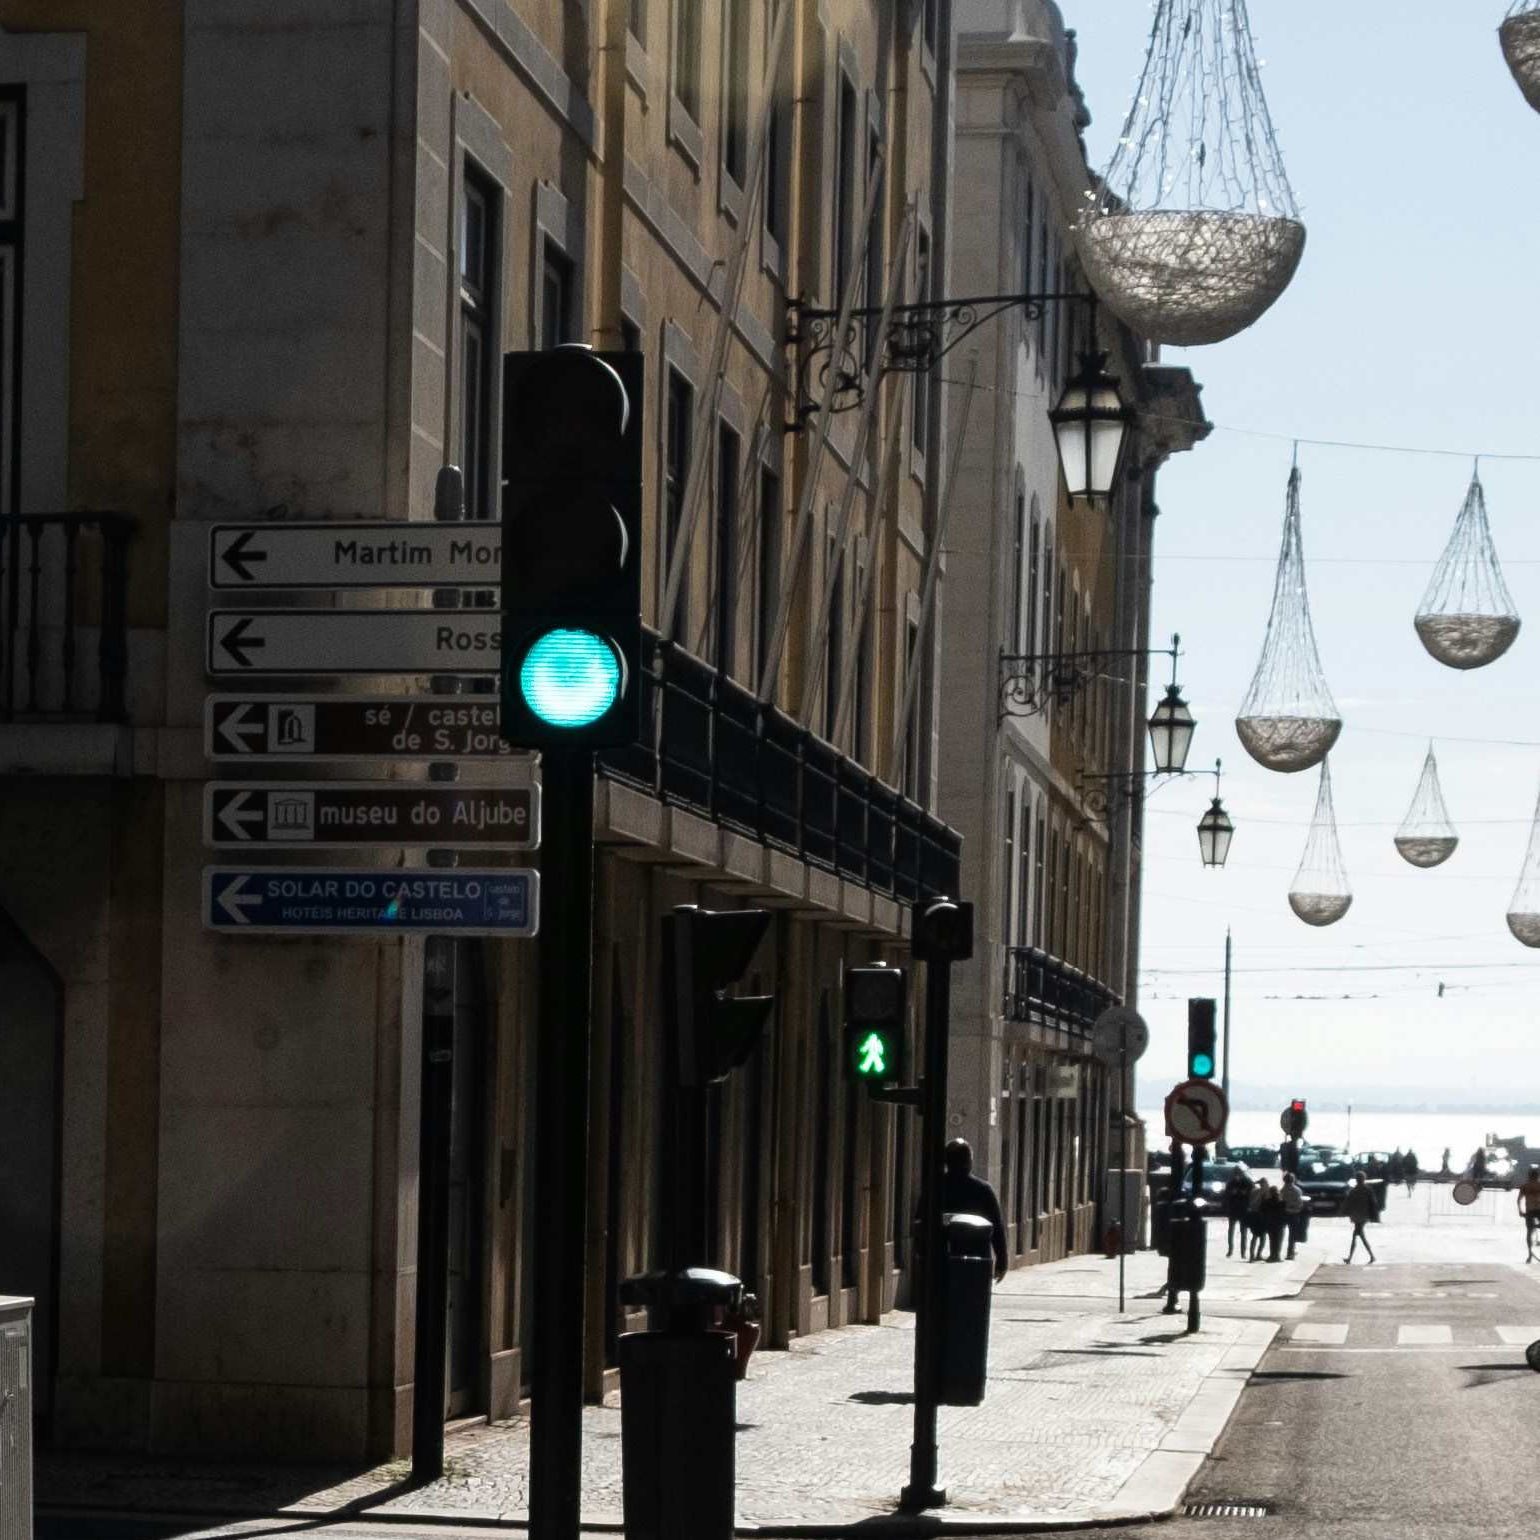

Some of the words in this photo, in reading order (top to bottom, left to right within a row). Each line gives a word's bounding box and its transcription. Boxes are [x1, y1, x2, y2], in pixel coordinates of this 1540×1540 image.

[334, 540, 432, 564] Martim
[365, 704, 392, 726] sé
[392, 729, 421, 750] de
[434, 728, 456, 750] S.
[320, 805, 398, 825] museu
[411, 801, 440, 825] do
[452, 801, 527, 831] Aljube
[267, 880, 339, 898] SOLAR
[345, 881, 376, 899] DO
[382, 881, 481, 899] CASTELO
[282, 904, 334, 919] HOTÉIS
[411, 907, 464, 920] LISBOA
